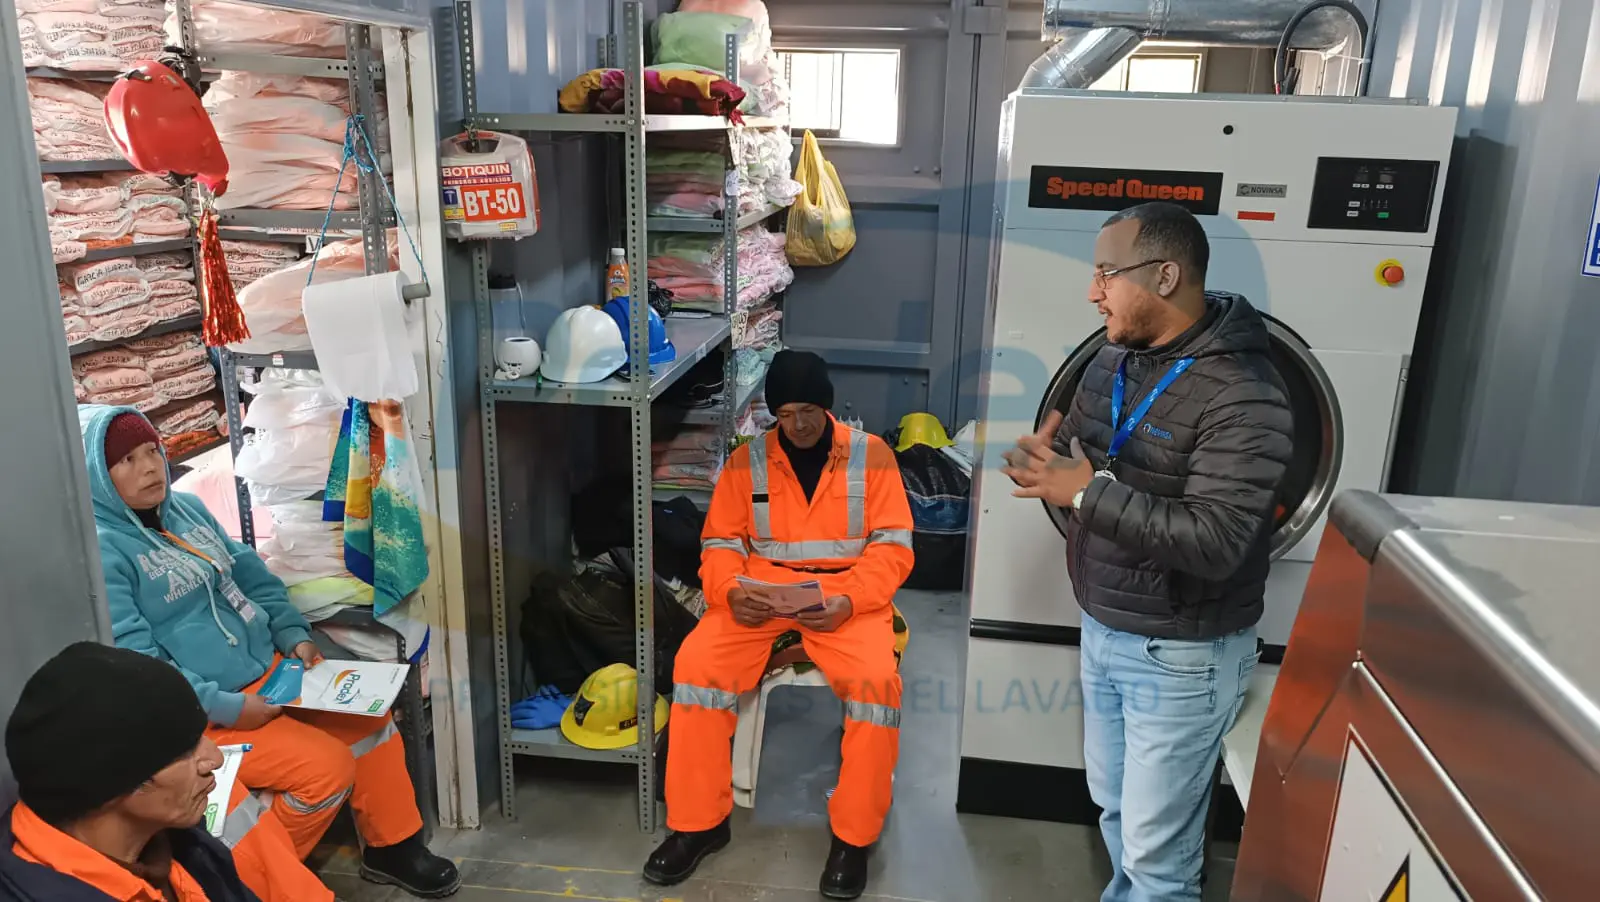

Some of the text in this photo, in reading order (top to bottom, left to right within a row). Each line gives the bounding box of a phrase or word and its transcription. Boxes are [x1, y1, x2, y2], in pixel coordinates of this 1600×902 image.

[442, 164, 509, 178] BOTIQUIN
[1047, 176, 1204, 201] Speed Queen
[1250, 186, 1283, 194] NOVINSA
[464, 188, 520, 216] BT-50
